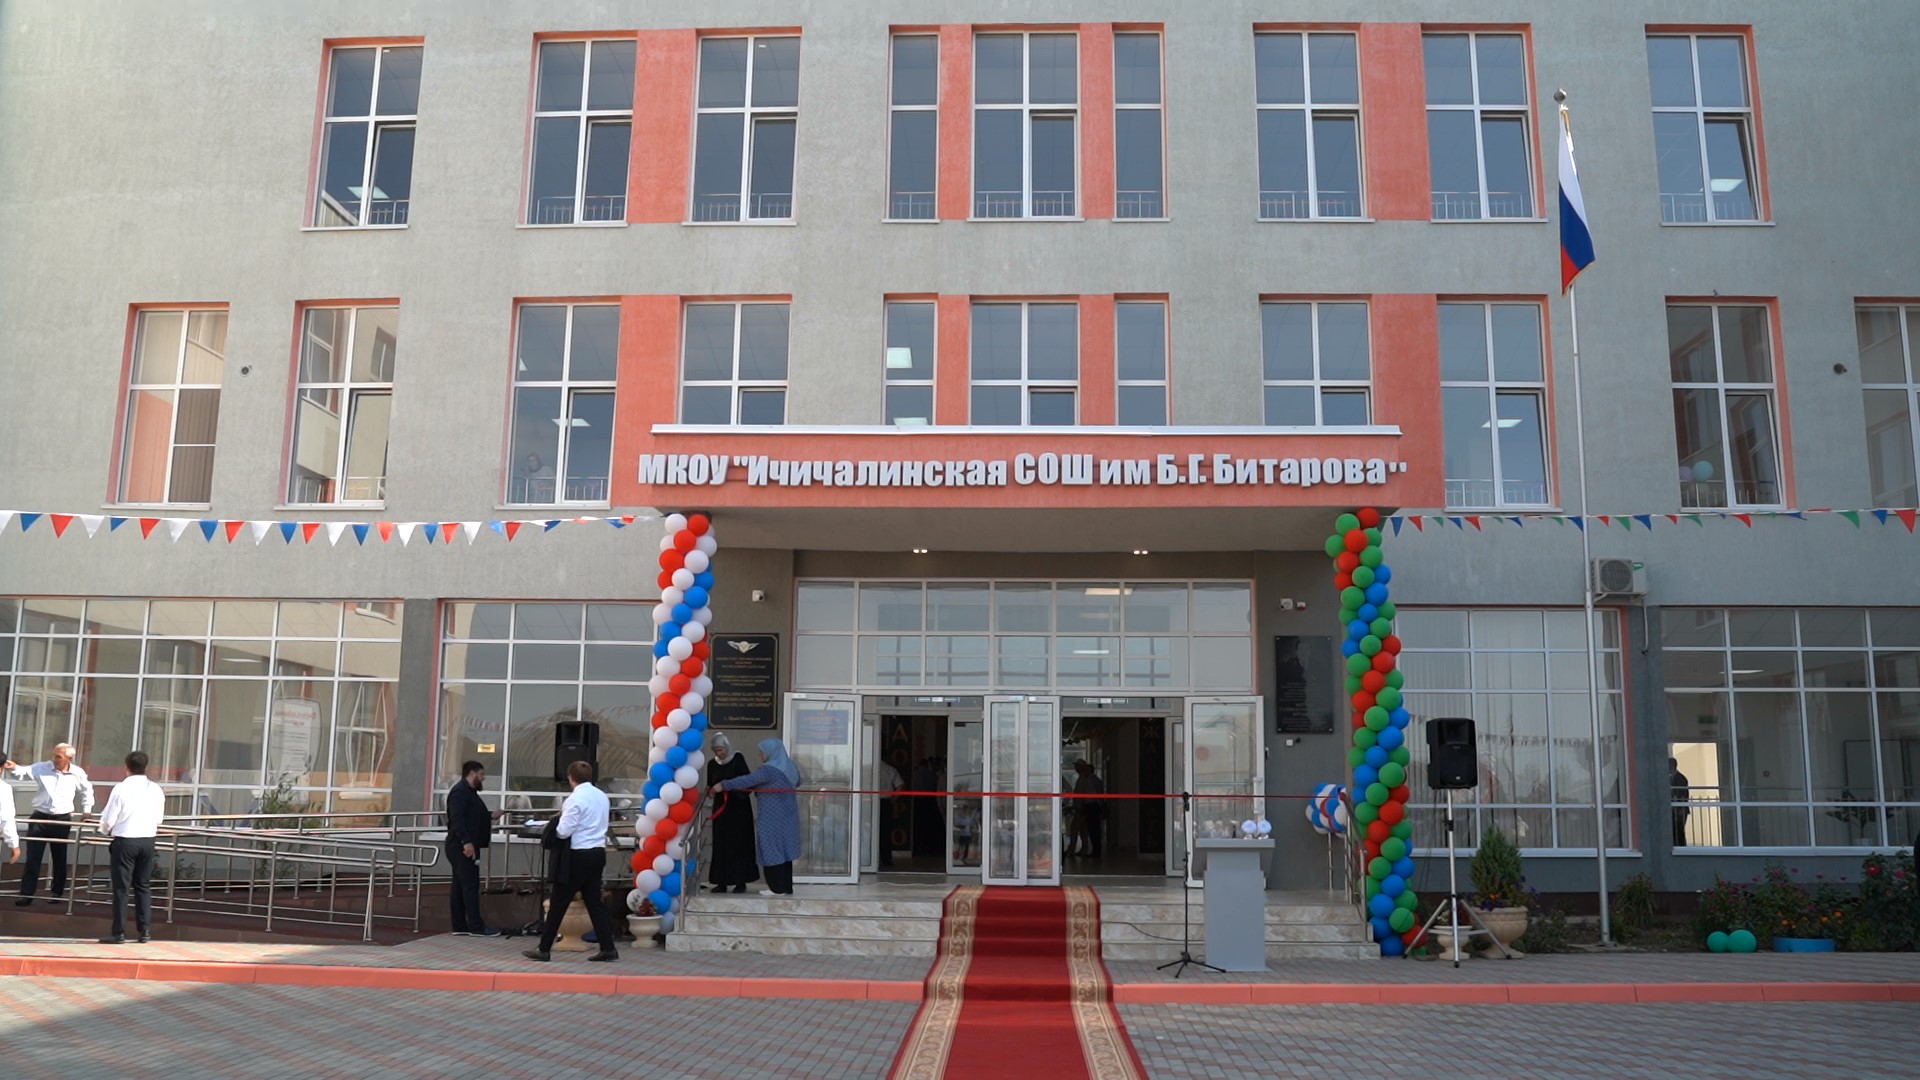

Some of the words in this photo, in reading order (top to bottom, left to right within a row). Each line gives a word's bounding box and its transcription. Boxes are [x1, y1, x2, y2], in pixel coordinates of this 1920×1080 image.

[638, 453, 729, 486] МКОУ
[733, 454, 1008, 487] "Ичичалинская
[1014, 452, 1093, 486] СОШ
[1100, 459, 1151, 486] им
[1157, 453, 1207, 486] Б.Г.
[1213, 453, 1407, 487] Битарова"
[891, 722, 909, 847] ДОРО
